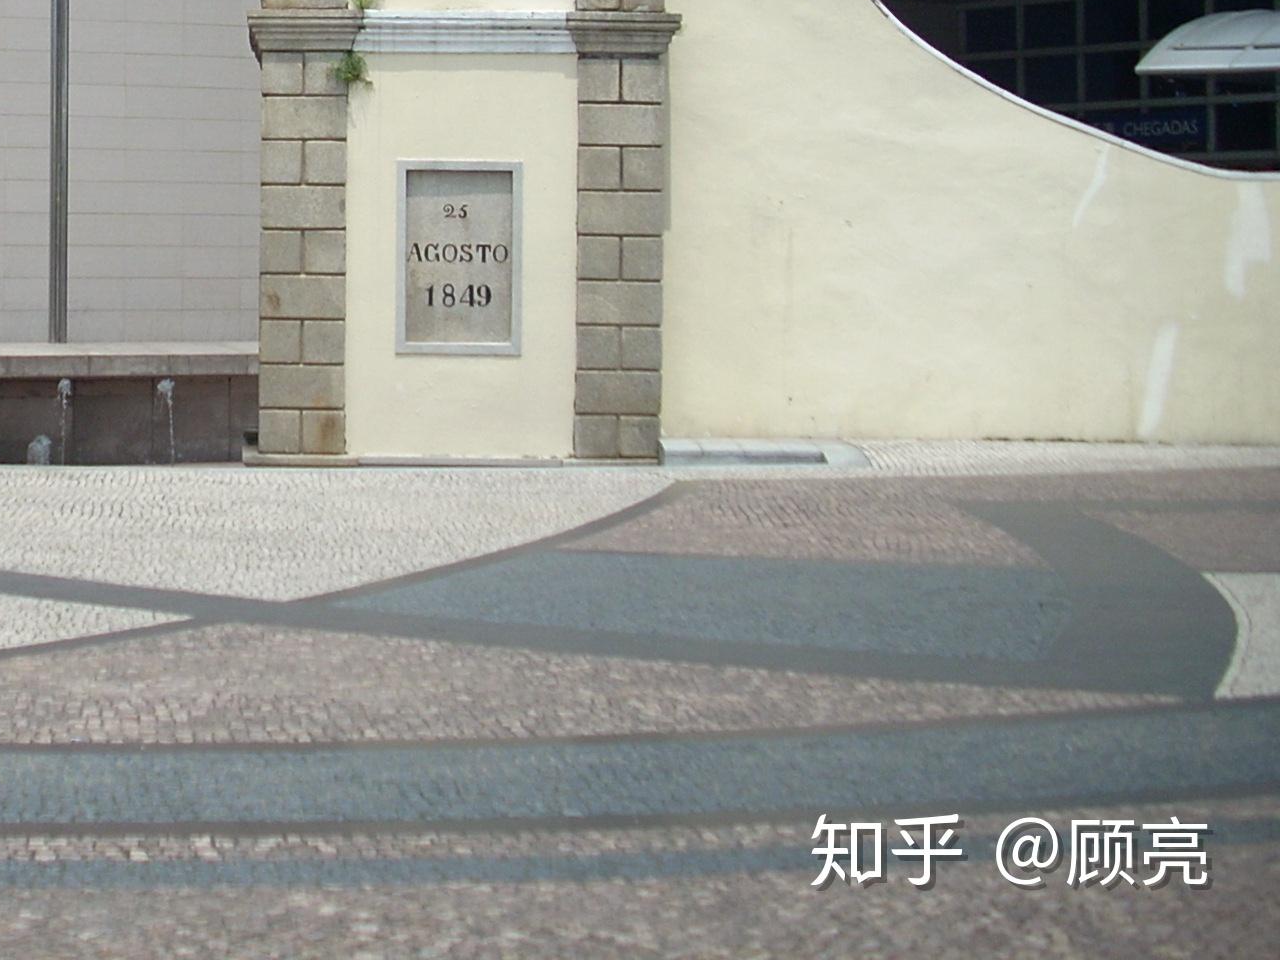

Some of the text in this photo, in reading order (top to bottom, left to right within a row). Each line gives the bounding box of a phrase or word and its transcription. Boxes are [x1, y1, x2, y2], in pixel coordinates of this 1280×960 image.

[1123, 120, 1199, 137] CHEGADAS
[442, 203, 468, 219] 25
[407, 243, 509, 263] AGOSTO
[425, 283, 492, 308] 1849
